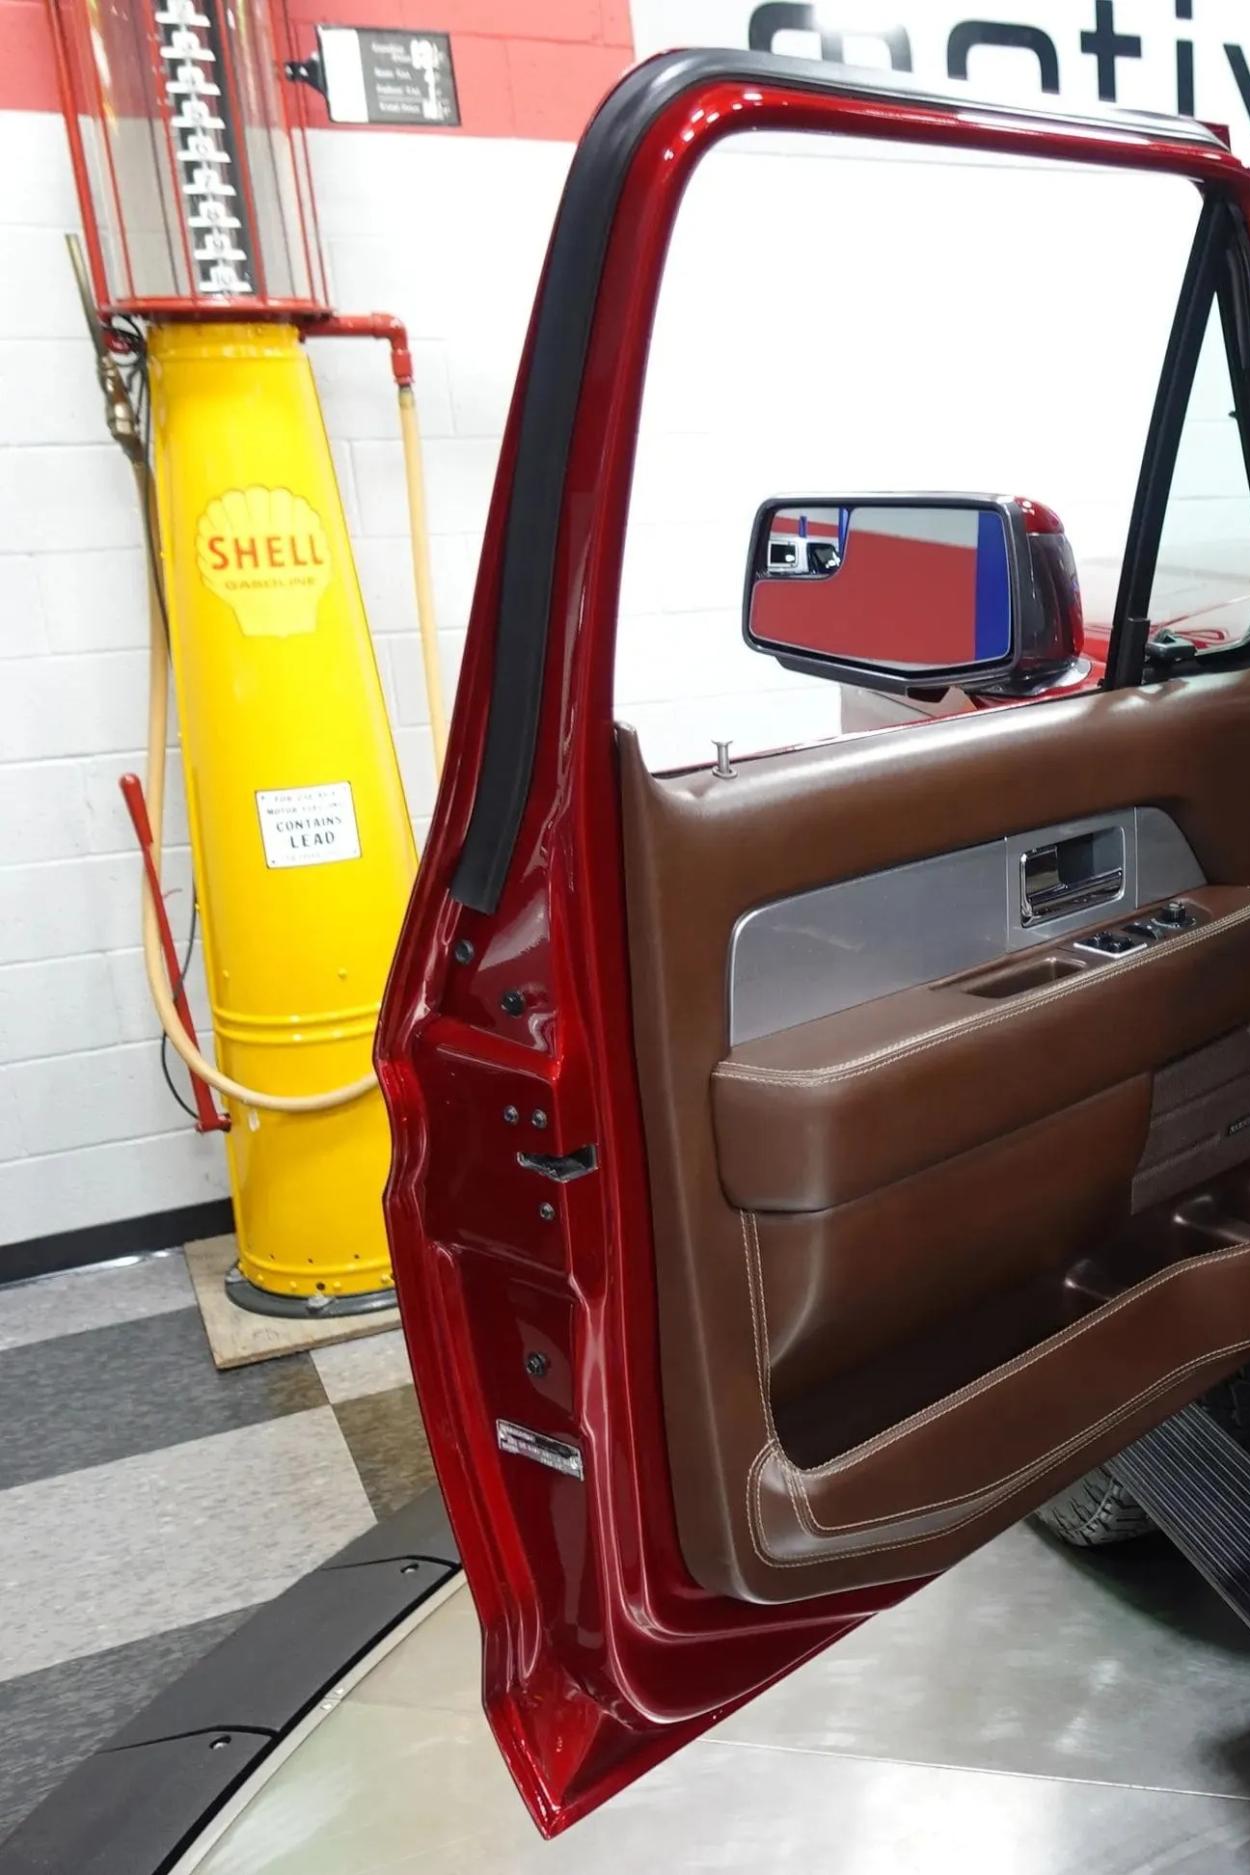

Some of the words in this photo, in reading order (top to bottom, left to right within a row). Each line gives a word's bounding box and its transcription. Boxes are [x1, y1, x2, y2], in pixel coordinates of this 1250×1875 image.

[207, 534, 324, 570] SHELL
[276, 815, 342, 833] CONTAINS
[290, 831, 335, 849] LEAD
